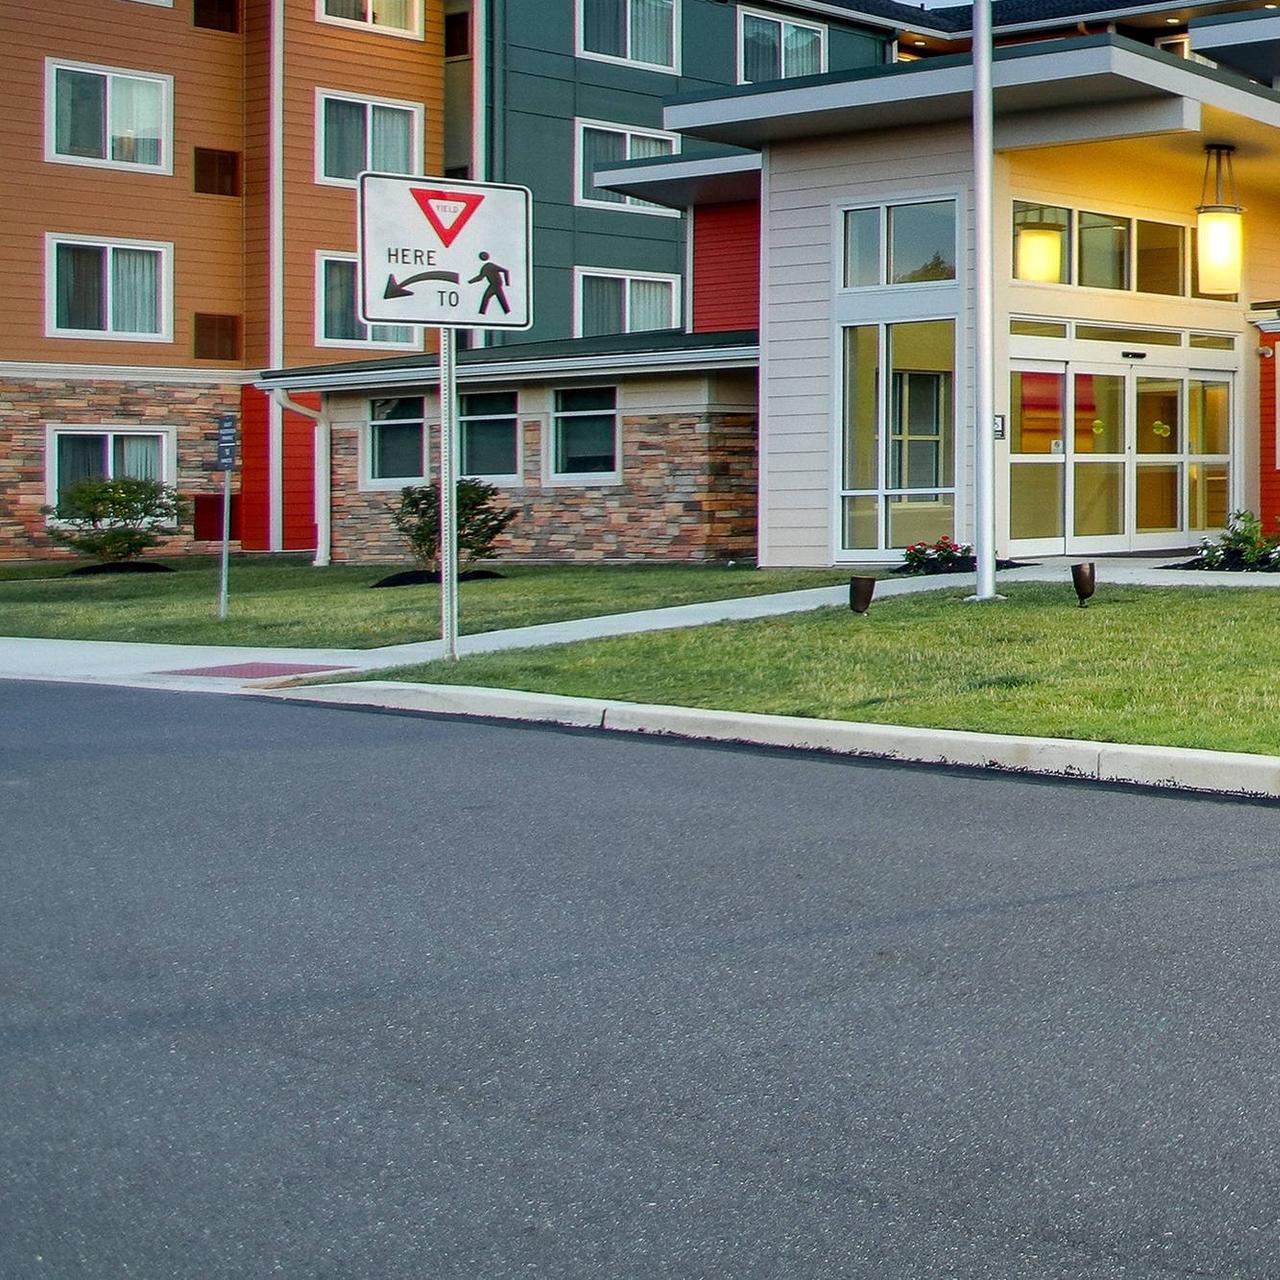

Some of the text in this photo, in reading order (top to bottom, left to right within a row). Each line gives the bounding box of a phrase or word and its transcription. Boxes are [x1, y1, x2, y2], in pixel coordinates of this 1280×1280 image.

[436, 204, 459, 214] YIELD
[388, 247, 437, 266] HERE
[438, 290, 459, 307] TO
